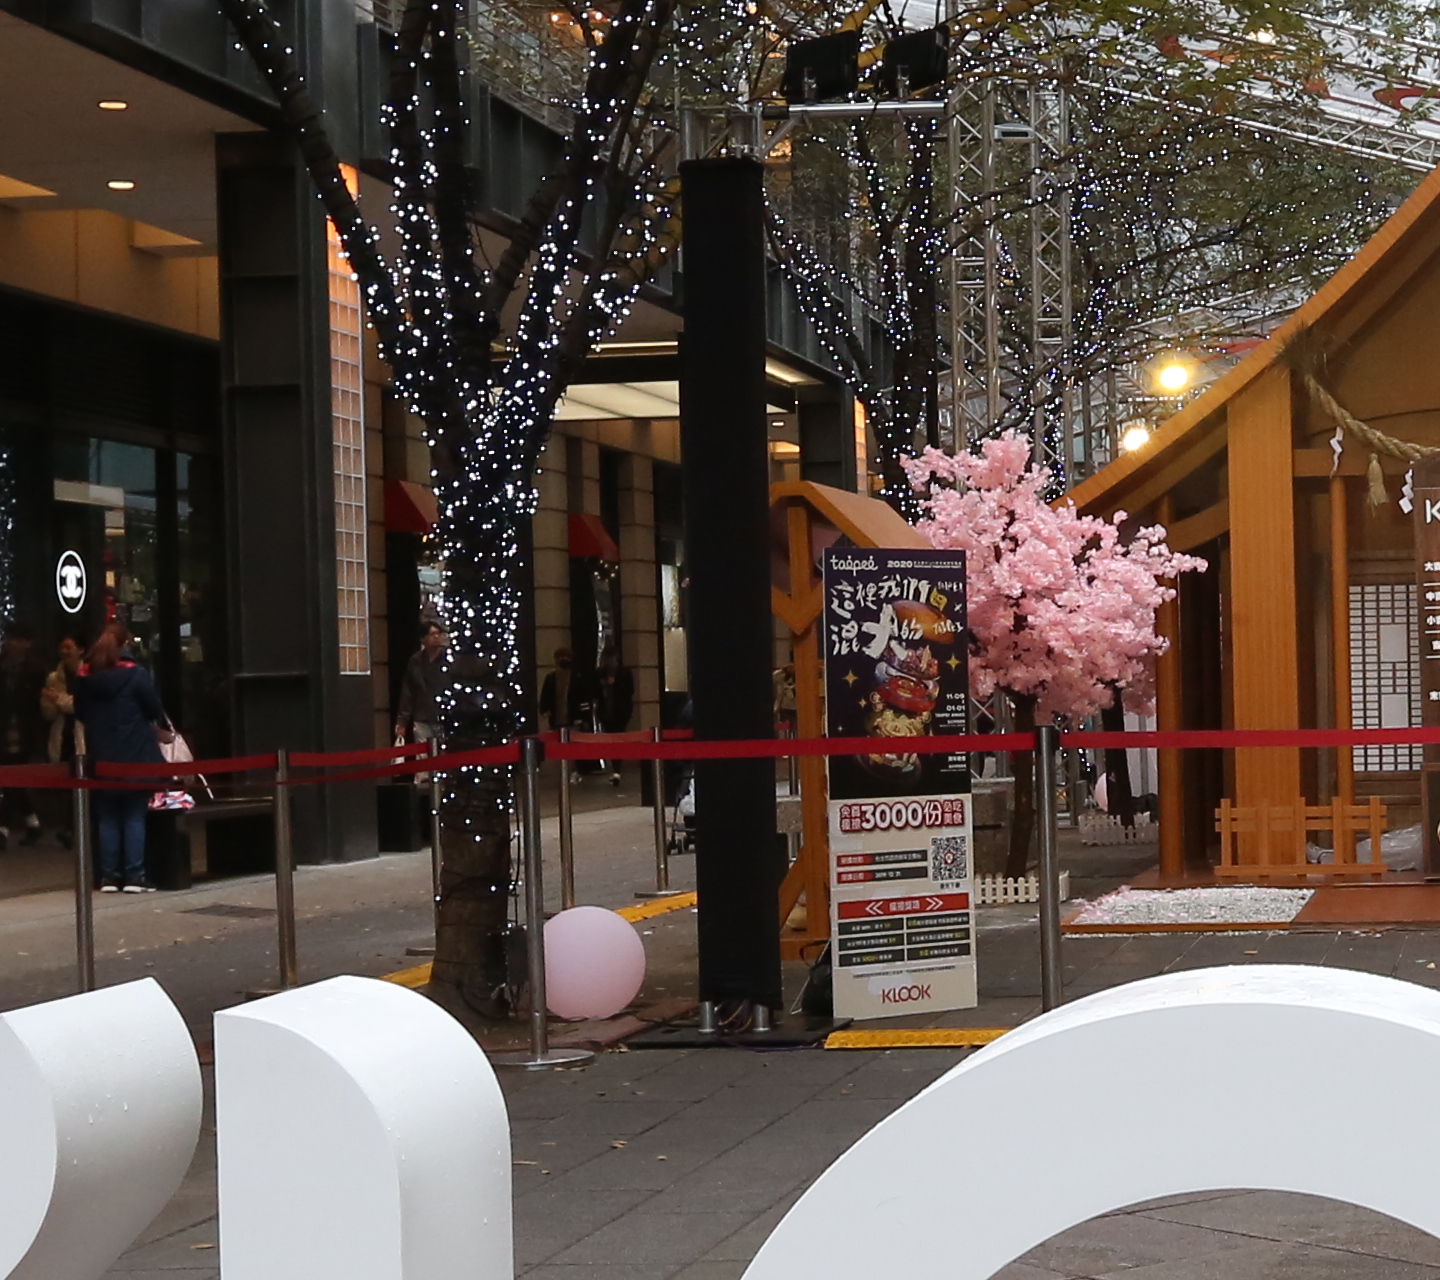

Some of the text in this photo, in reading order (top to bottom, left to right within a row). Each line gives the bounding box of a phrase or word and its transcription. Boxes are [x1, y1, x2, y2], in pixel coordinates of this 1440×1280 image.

[887, 560, 913, 569] 2020
[861, 801, 942, 829] 3000份
[881, 984, 932, 1004] KLOOK
